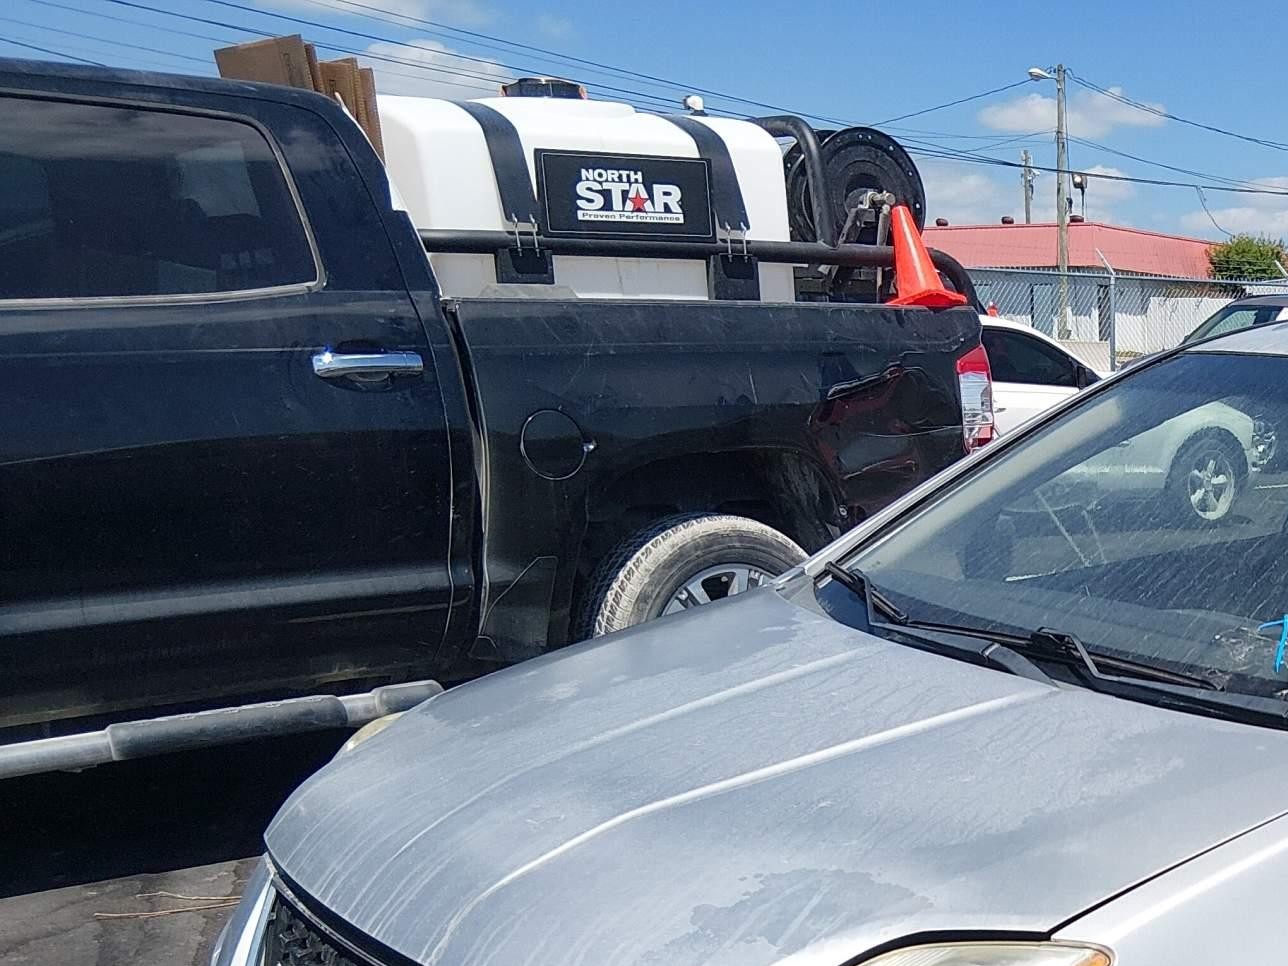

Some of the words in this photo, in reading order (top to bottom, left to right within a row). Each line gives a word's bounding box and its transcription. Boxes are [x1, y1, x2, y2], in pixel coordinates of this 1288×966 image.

[581, 168, 643, 183] NORTH
[576, 181, 683, 213] STAR
[582, 212, 616, 220] Proven
[619, 213, 681, 222] Performance
